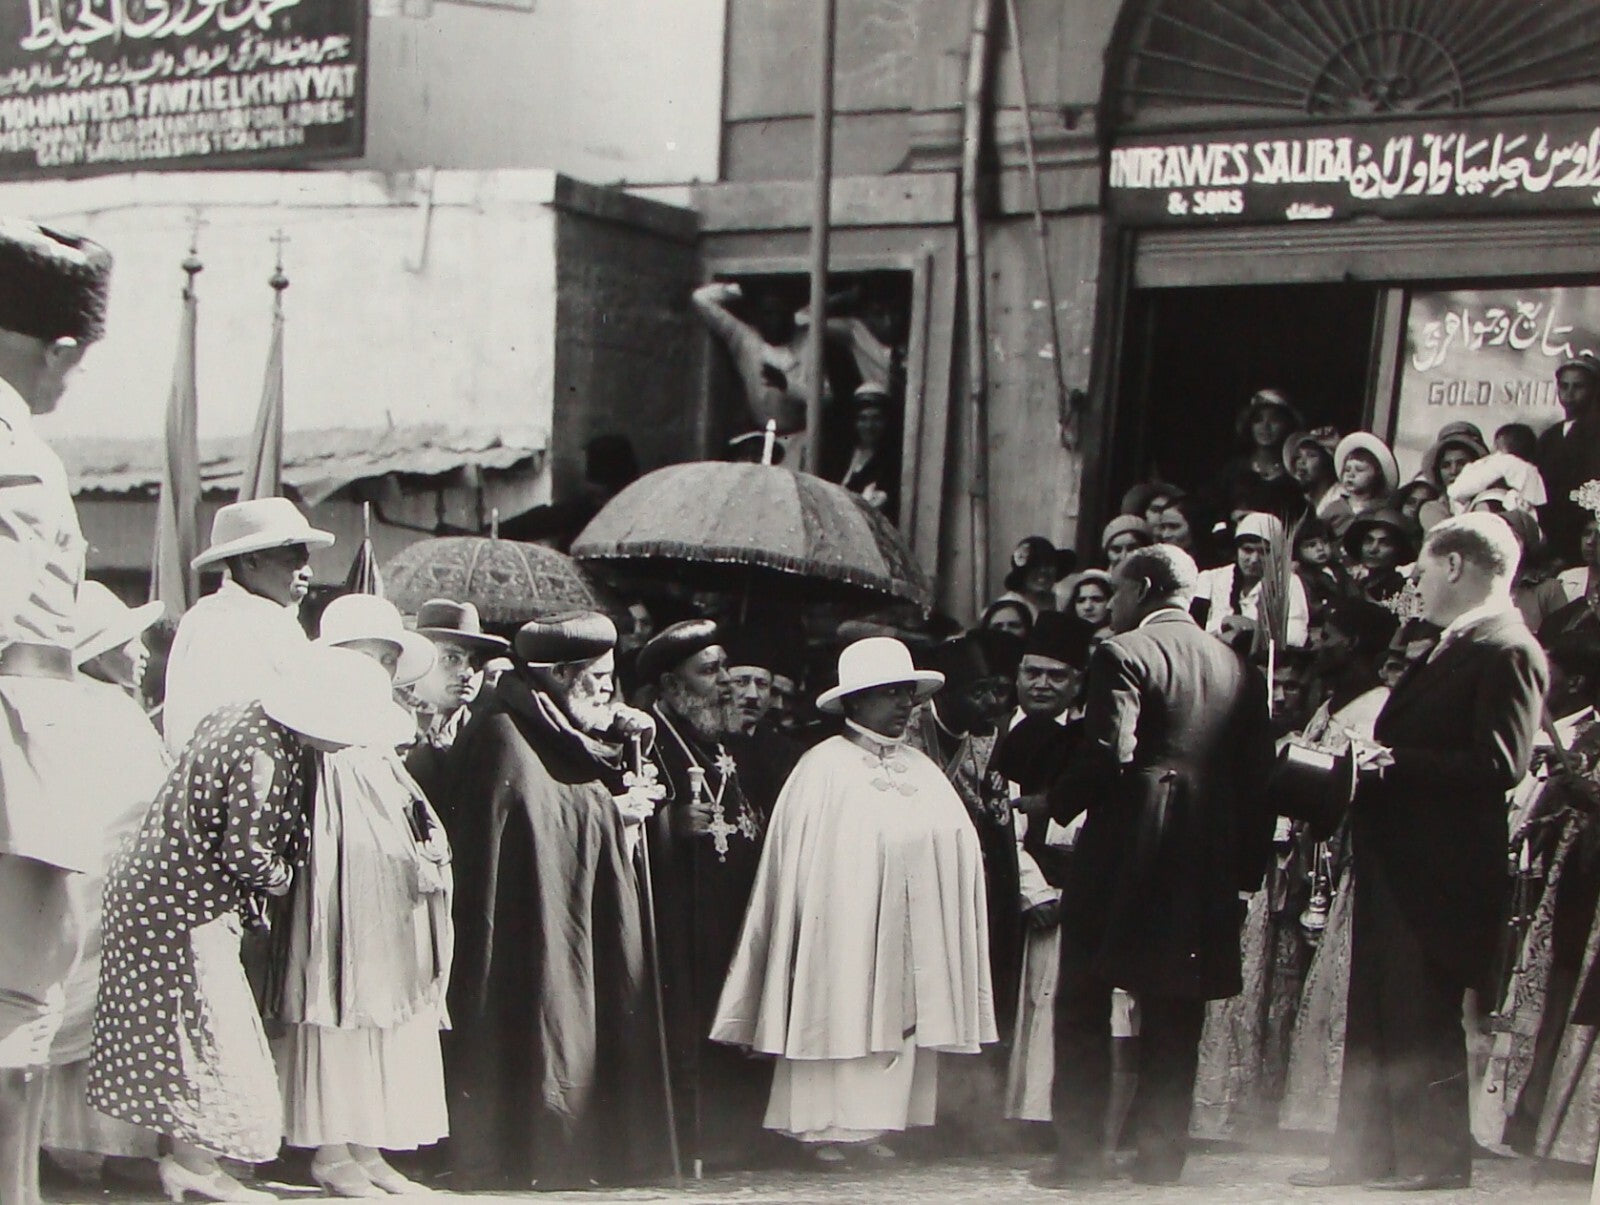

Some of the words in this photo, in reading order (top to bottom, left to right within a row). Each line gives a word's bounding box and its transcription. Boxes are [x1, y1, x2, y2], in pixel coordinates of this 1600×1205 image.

[1252, 137, 1352, 184] SALIBA
[1167, 191, 1188, 215] &
[1192, 189, 1244, 214] SONS
[1427, 380, 1494, 407] GOLD
[1503, 378, 1560, 408] SMIT
